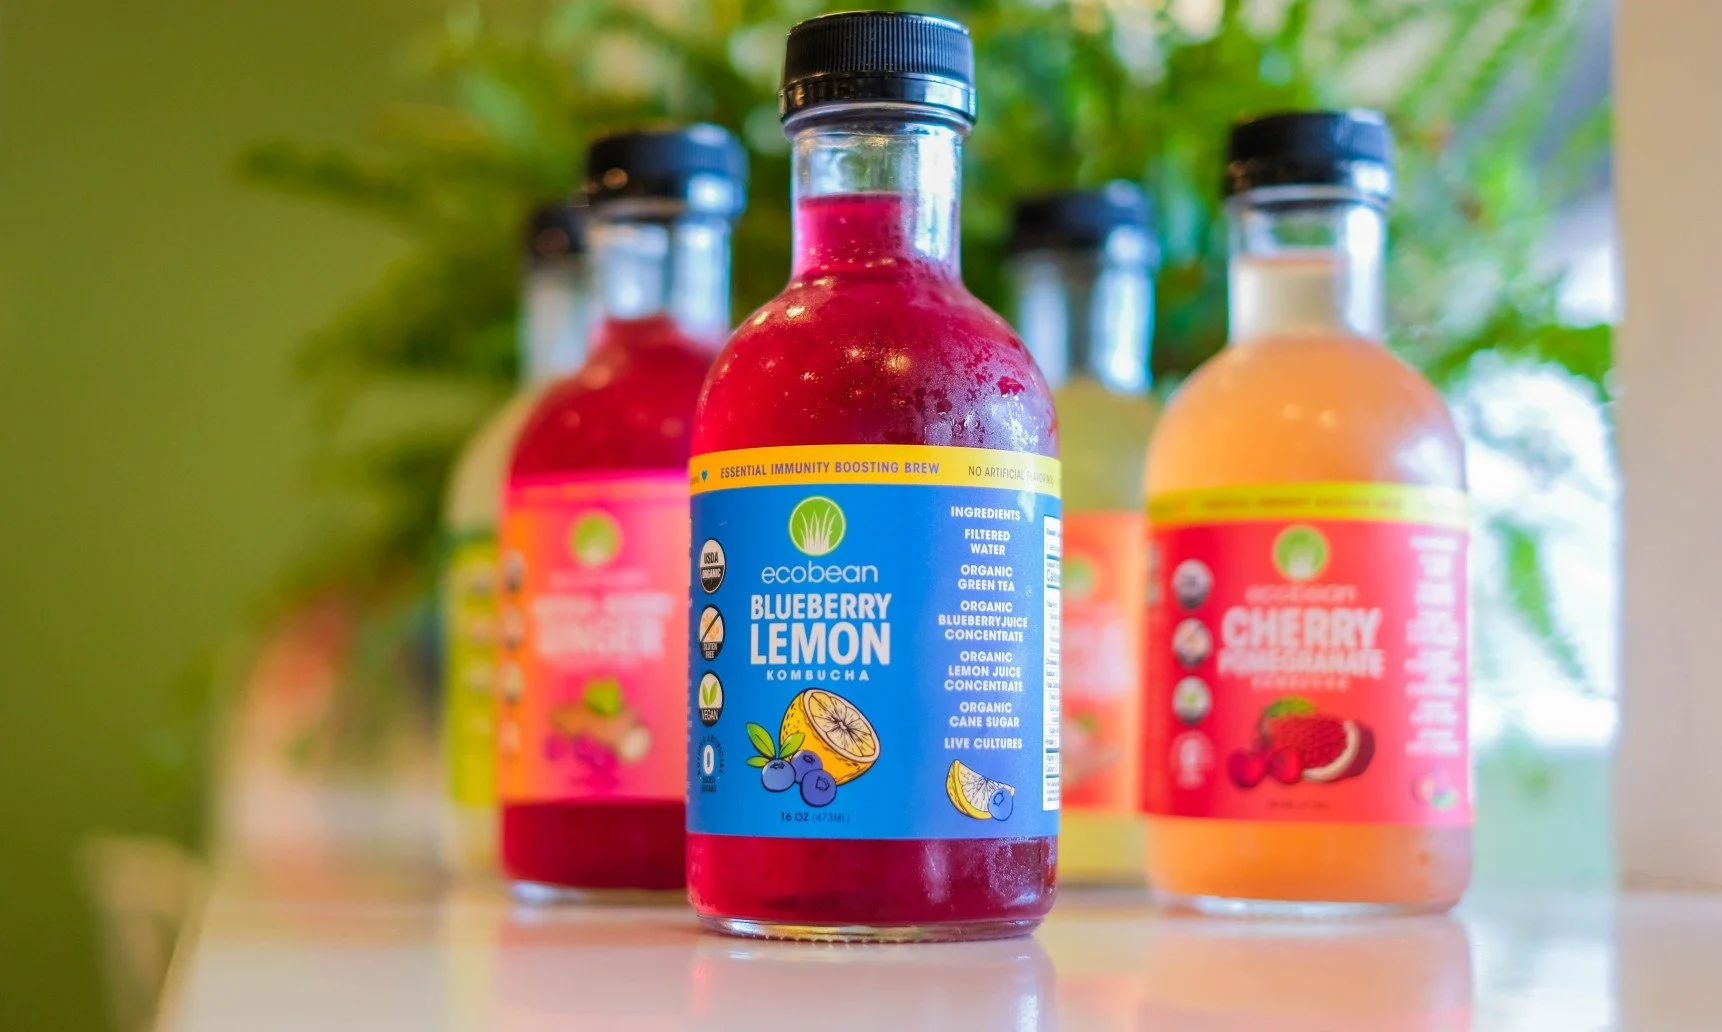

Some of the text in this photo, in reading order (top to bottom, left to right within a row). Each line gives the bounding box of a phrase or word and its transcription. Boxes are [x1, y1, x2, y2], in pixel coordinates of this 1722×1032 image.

[720, 461, 940, 479] ESSENTIAL IMMUNITY BOOSTING BREW
[968, 465, 981, 476] NO
[984, 466, 1024, 480] ARTIFICIAL
[950, 506, 1021, 521] INGREDIENTS
[964, 528, 1011, 541] FILTERED
[970, 543, 1006, 556] WATER
[704, 552, 719, 564] USDA
[702, 569, 721, 579] ORGANIC
[761, 560, 879, 584] ecobean
[960, 564, 1013, 577] ORGANIC
[957, 578, 1015, 592] GREEN TEA
[750, 593, 892, 620] BLUEBERRY
[960, 600, 1013, 613] ORGANIC
[1221, 606, 1381, 649] CHERRY
[944, 628, 1024, 643] CONCENTRATE
[750, 621, 891, 665] LEMON
[705, 651, 715, 659] FREE
[960, 650, 1013, 663] ORGANIC
[766, 669, 870, 681] KOMBUCHA
[948, 664, 1021, 678] LEMON JUICE
[944, 679, 1023, 692] CONCENTRATE
[959, 701, 1013, 714] ORGANIC
[701, 709, 718, 720] VEGAN
[949, 715, 1020, 728] CANE SUGAR
[944, 737, 1023, 750] LIVE CULTURES
[780, 812, 792, 822] 16
[794, 812, 809, 822] OZ
